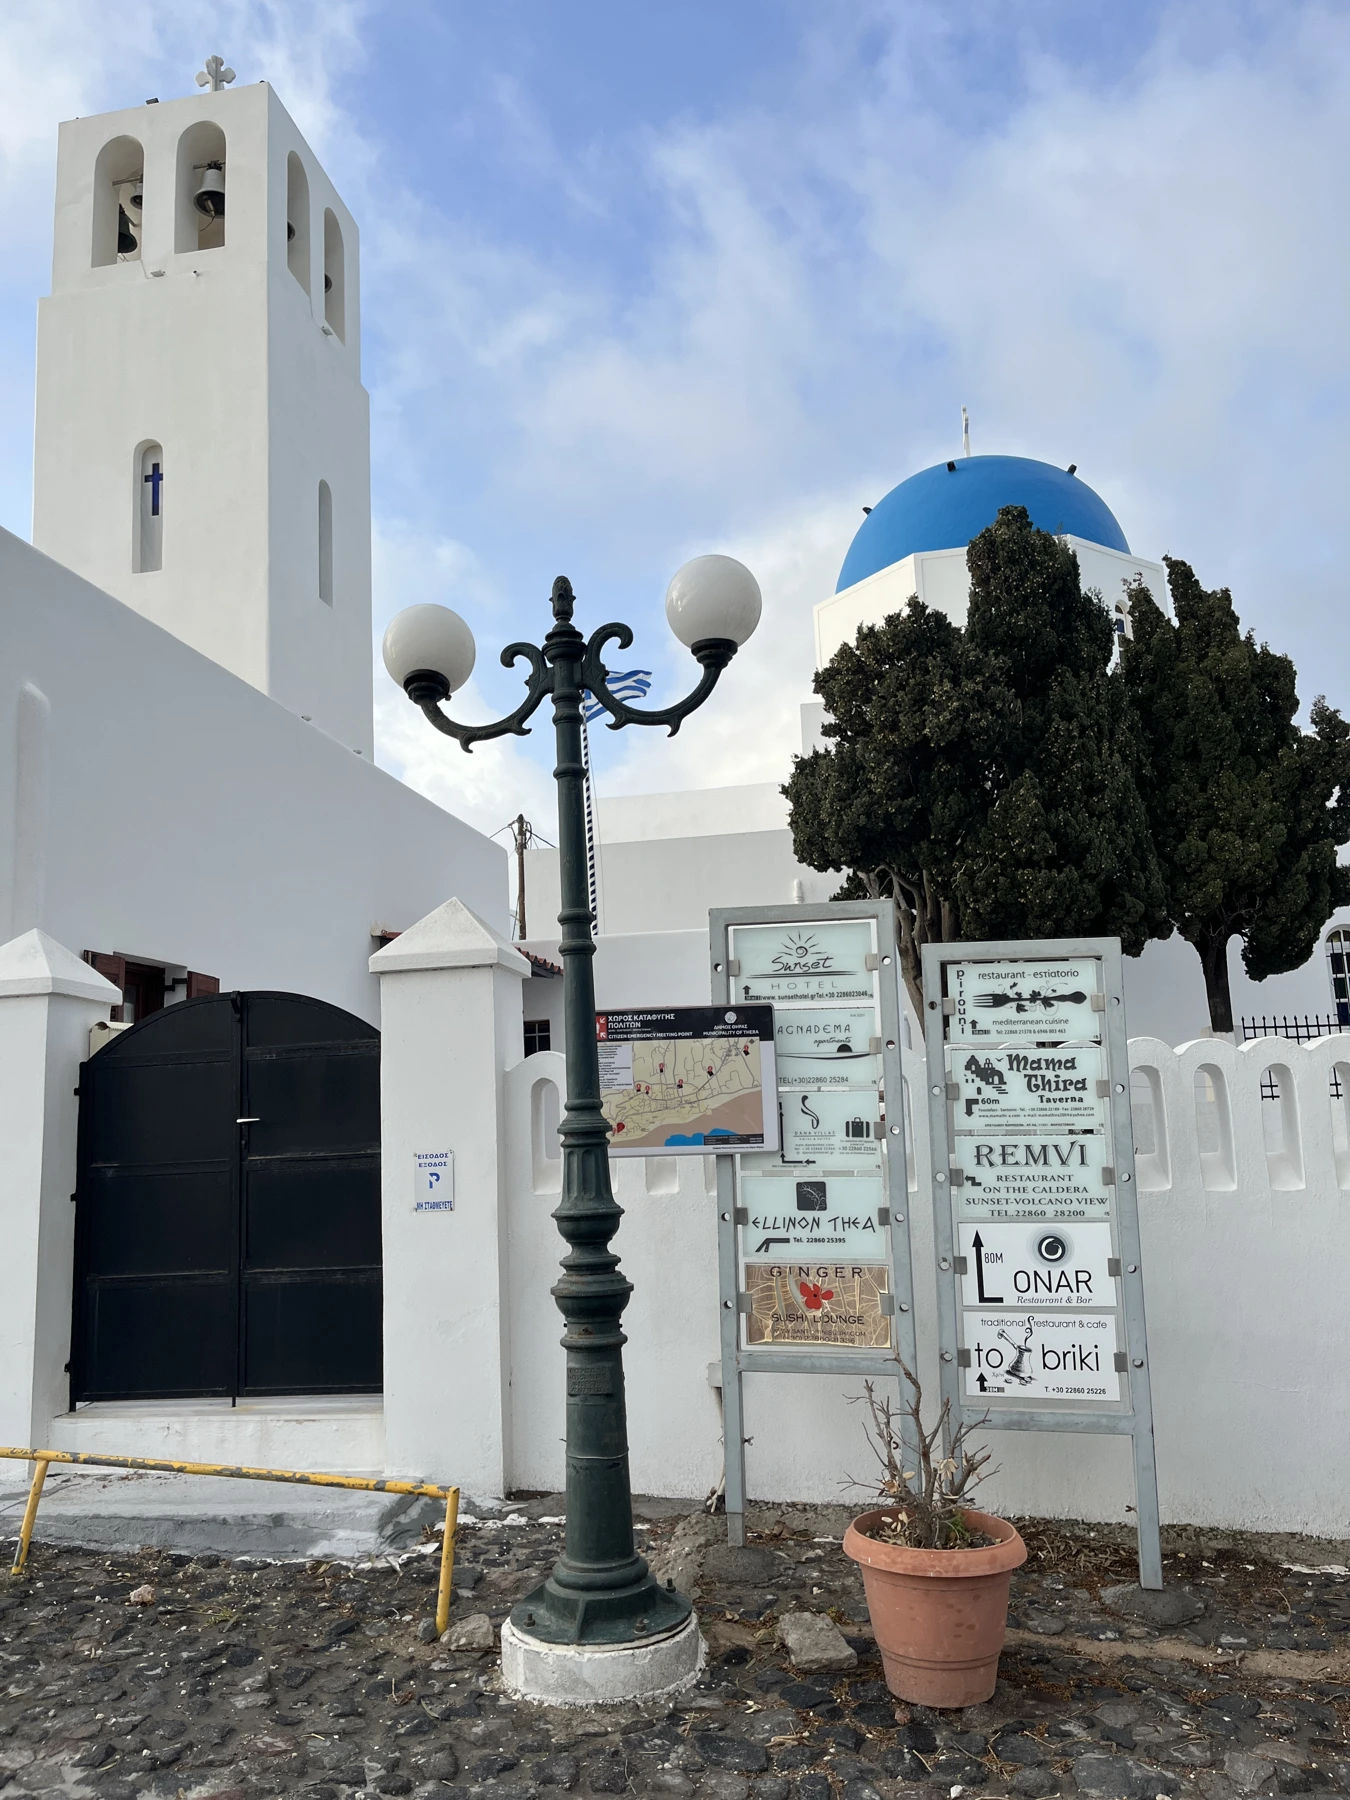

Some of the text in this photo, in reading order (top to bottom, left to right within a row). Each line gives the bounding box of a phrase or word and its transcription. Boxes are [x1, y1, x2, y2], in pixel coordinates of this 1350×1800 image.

[771, 955, 834, 972] Sunset
[978, 971, 1025, 979] restaurant
[771, 981, 838, 990] HOTEL
[956, 969, 967, 1035] pirouni
[608, 1013, 675, 1022] ΧΩΡΟΣ ΚΑΤΑΦΥΓΗΣ
[813, 1037, 852, 1047] apartments
[1006, 1054, 1077, 1072] Mama
[1024, 1074, 1087, 1092] Thira
[1038, 1095, 1083, 1104] Taverna
[974, 1140, 1089, 1169] REMVI
[996, 1174, 1074, 1182] RESTAURANT
[983, 1186, 1089, 1194] ON THE CALDERA
[965, 1197, 1108, 1205] SUNSET-VOLCANO VIEW
[989, 1209, 1085, 1217] TEL.22860 28200
[751, 1216, 876, 1233] ELLINON THEA
[984, 1253, 1003, 1264] 80M
[770, 1266, 863, 1278] GINGER
[1014, 1270, 1093, 1293] ONAR
[1017, 1296, 1092, 1304] Restaurant & Bar
[813, 1314, 865, 1324] LOUNGE
[981, 1318, 1107, 1329] traditional restaurant & cafe
[975, 1343, 1099, 1371] to briki
[1086, 1387, 1106, 1395] 25226
